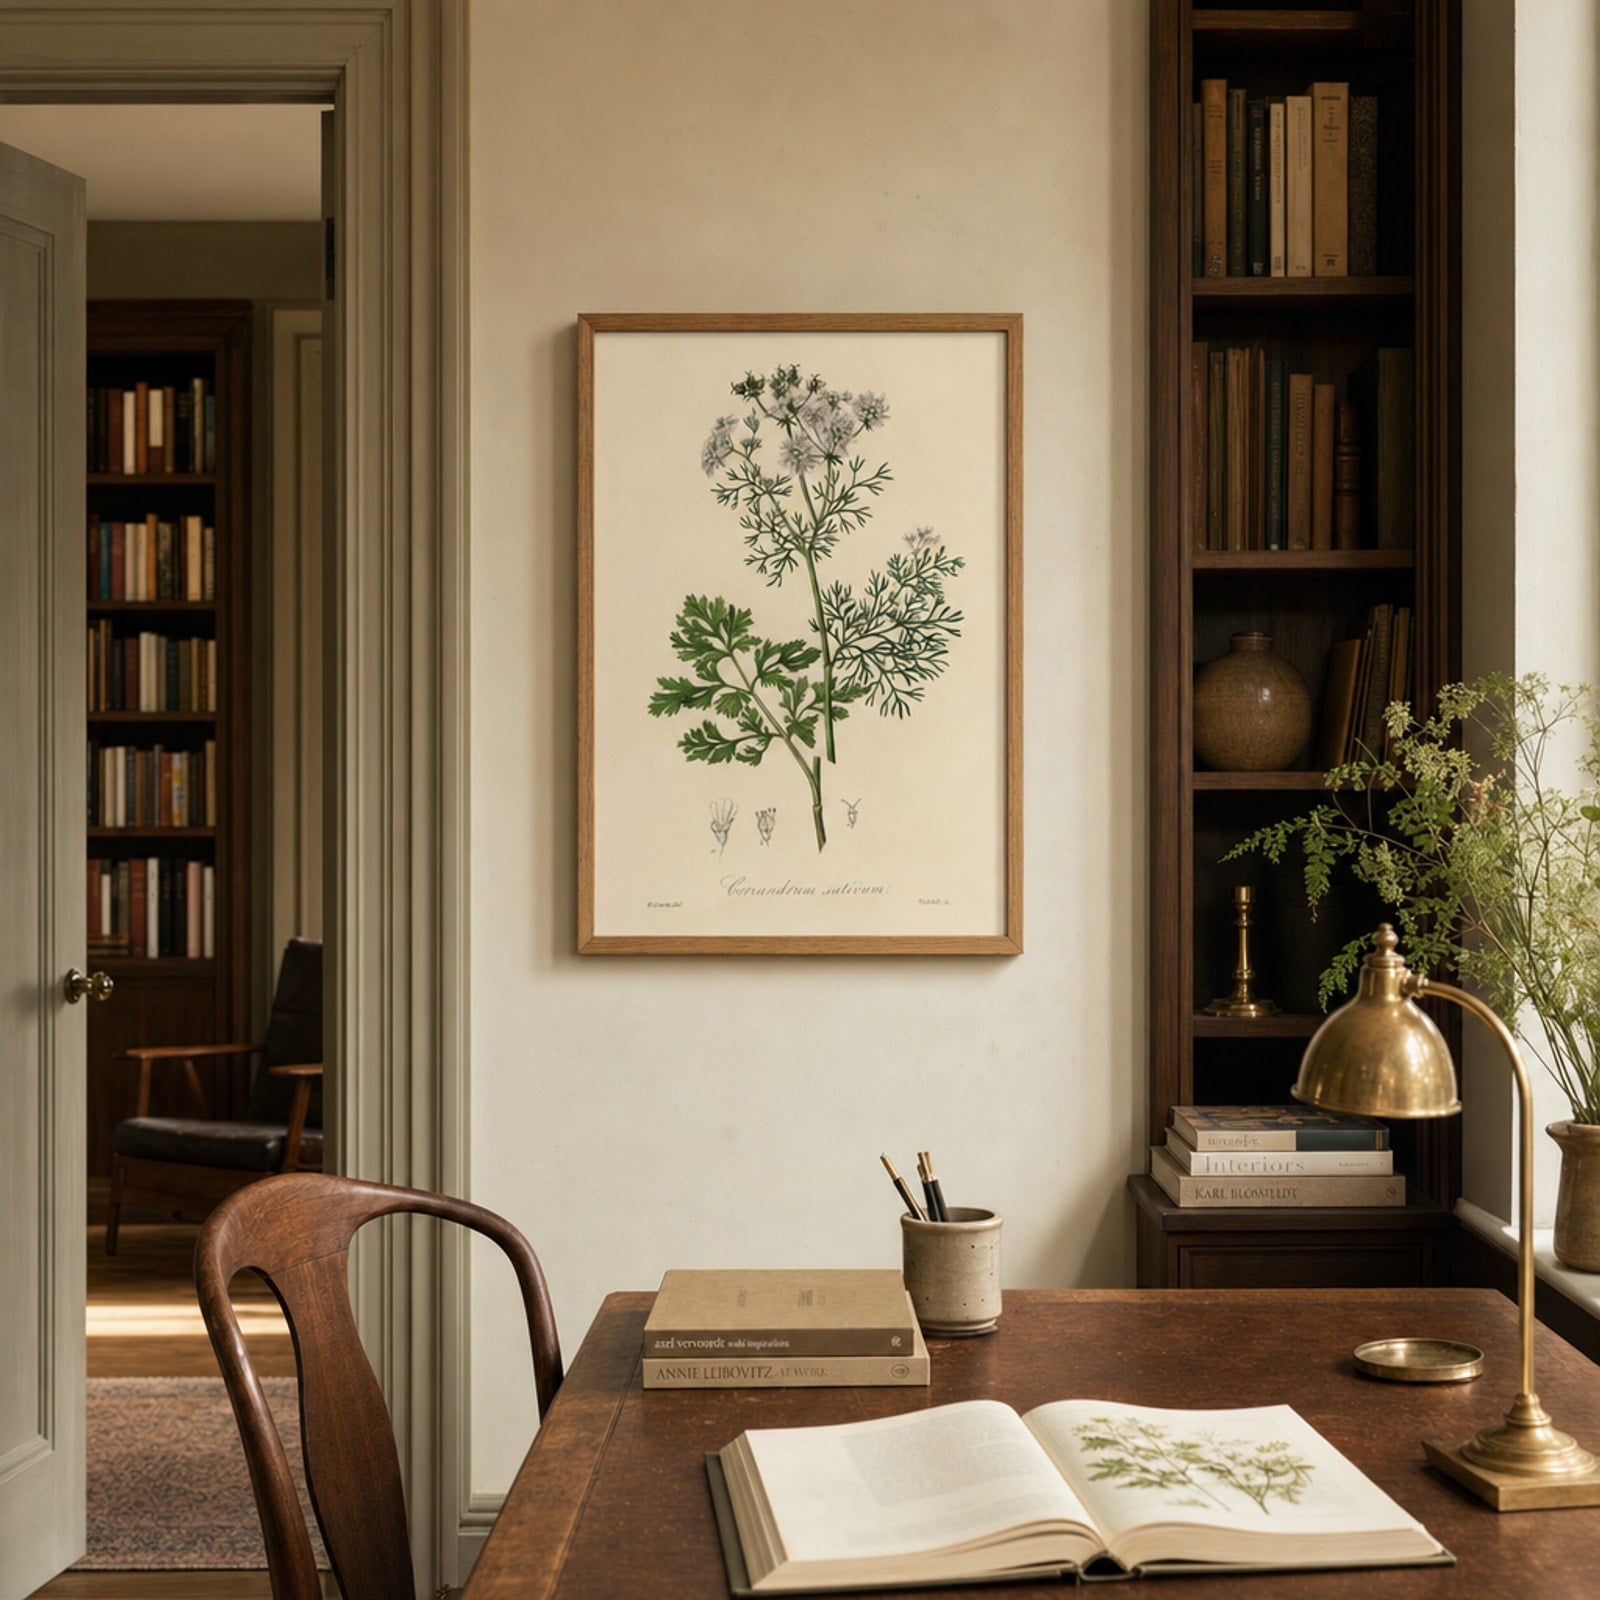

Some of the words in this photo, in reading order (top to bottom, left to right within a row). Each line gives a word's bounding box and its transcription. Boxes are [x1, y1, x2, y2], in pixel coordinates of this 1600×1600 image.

[1206, 1155, 1305, 1174] Interiors
[1195, 1187, 1226, 1200] KARL
[656, 1367, 701, 1381] ANNIE
[703, 1365, 773, 1380] LEIBOVITZ
